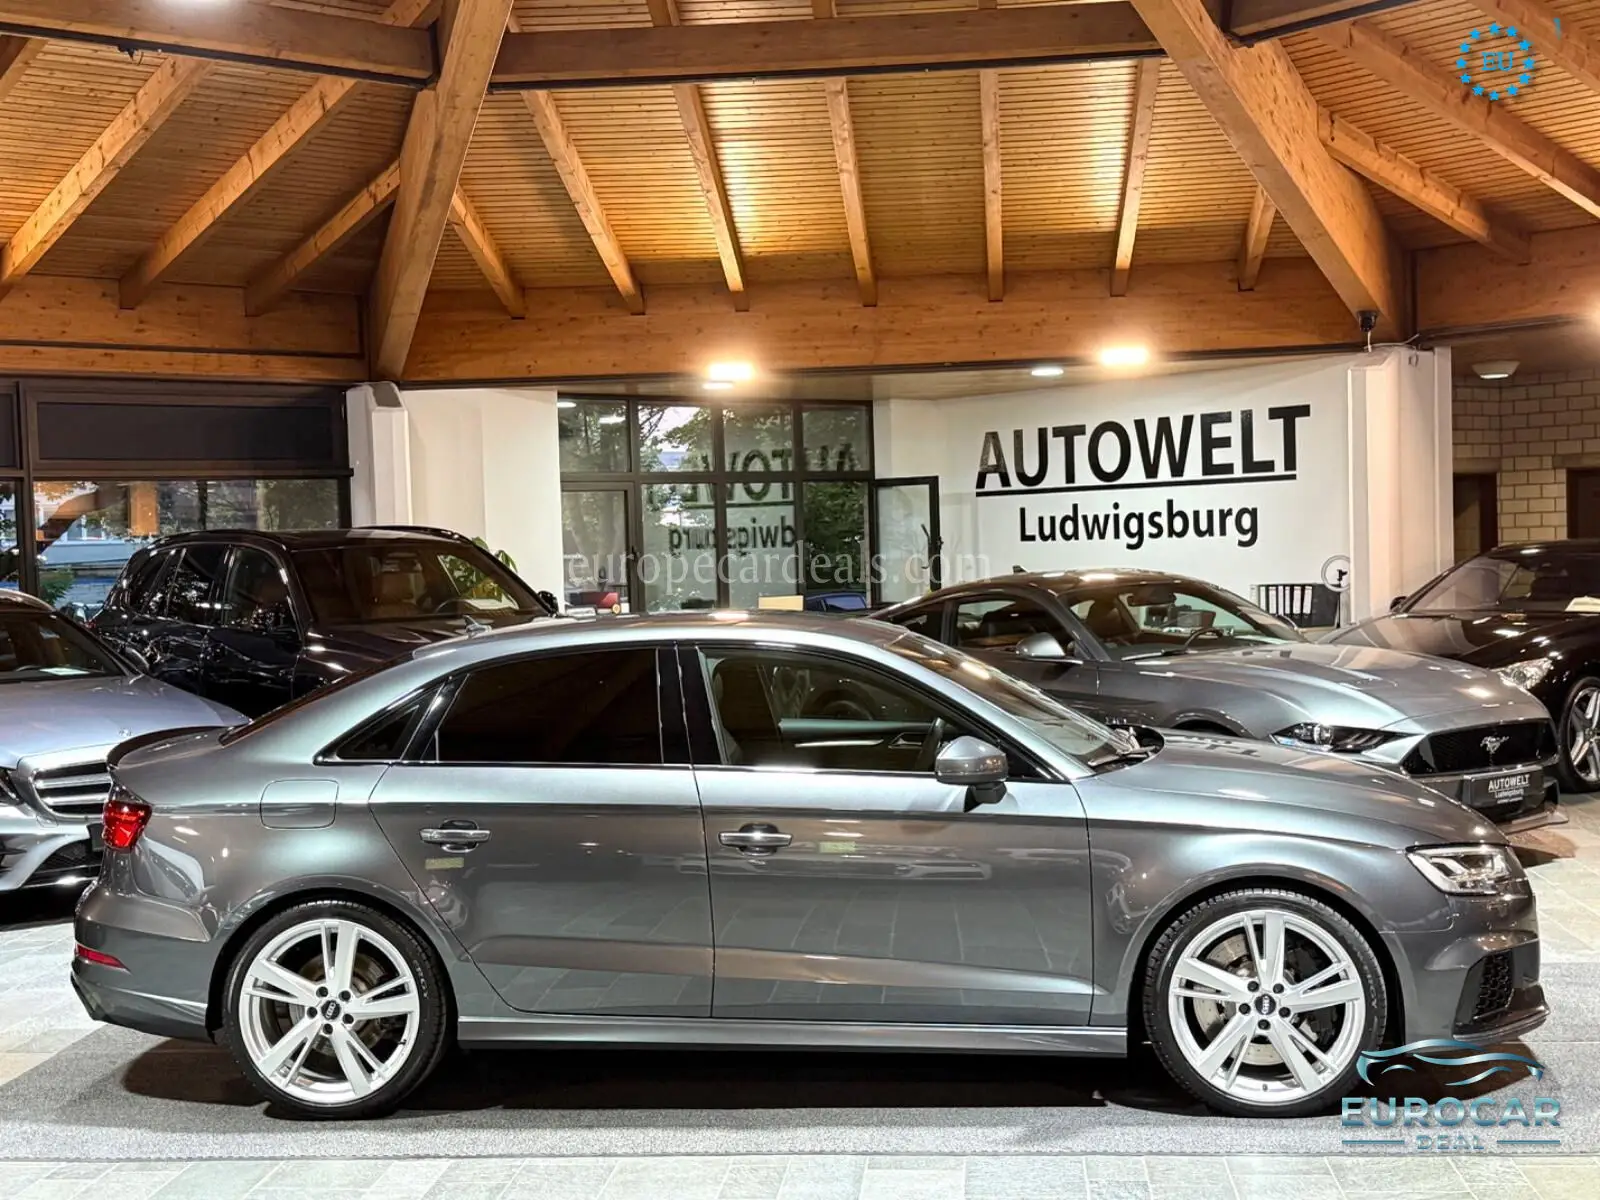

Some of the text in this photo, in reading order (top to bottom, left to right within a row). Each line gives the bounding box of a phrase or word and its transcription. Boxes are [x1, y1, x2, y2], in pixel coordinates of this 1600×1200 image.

[975, 404, 1311, 489] AUTOWELT
[1019, 499, 1259, 551] Ludwigsburg
[1488, 774, 1531, 791] AUTOWELT
